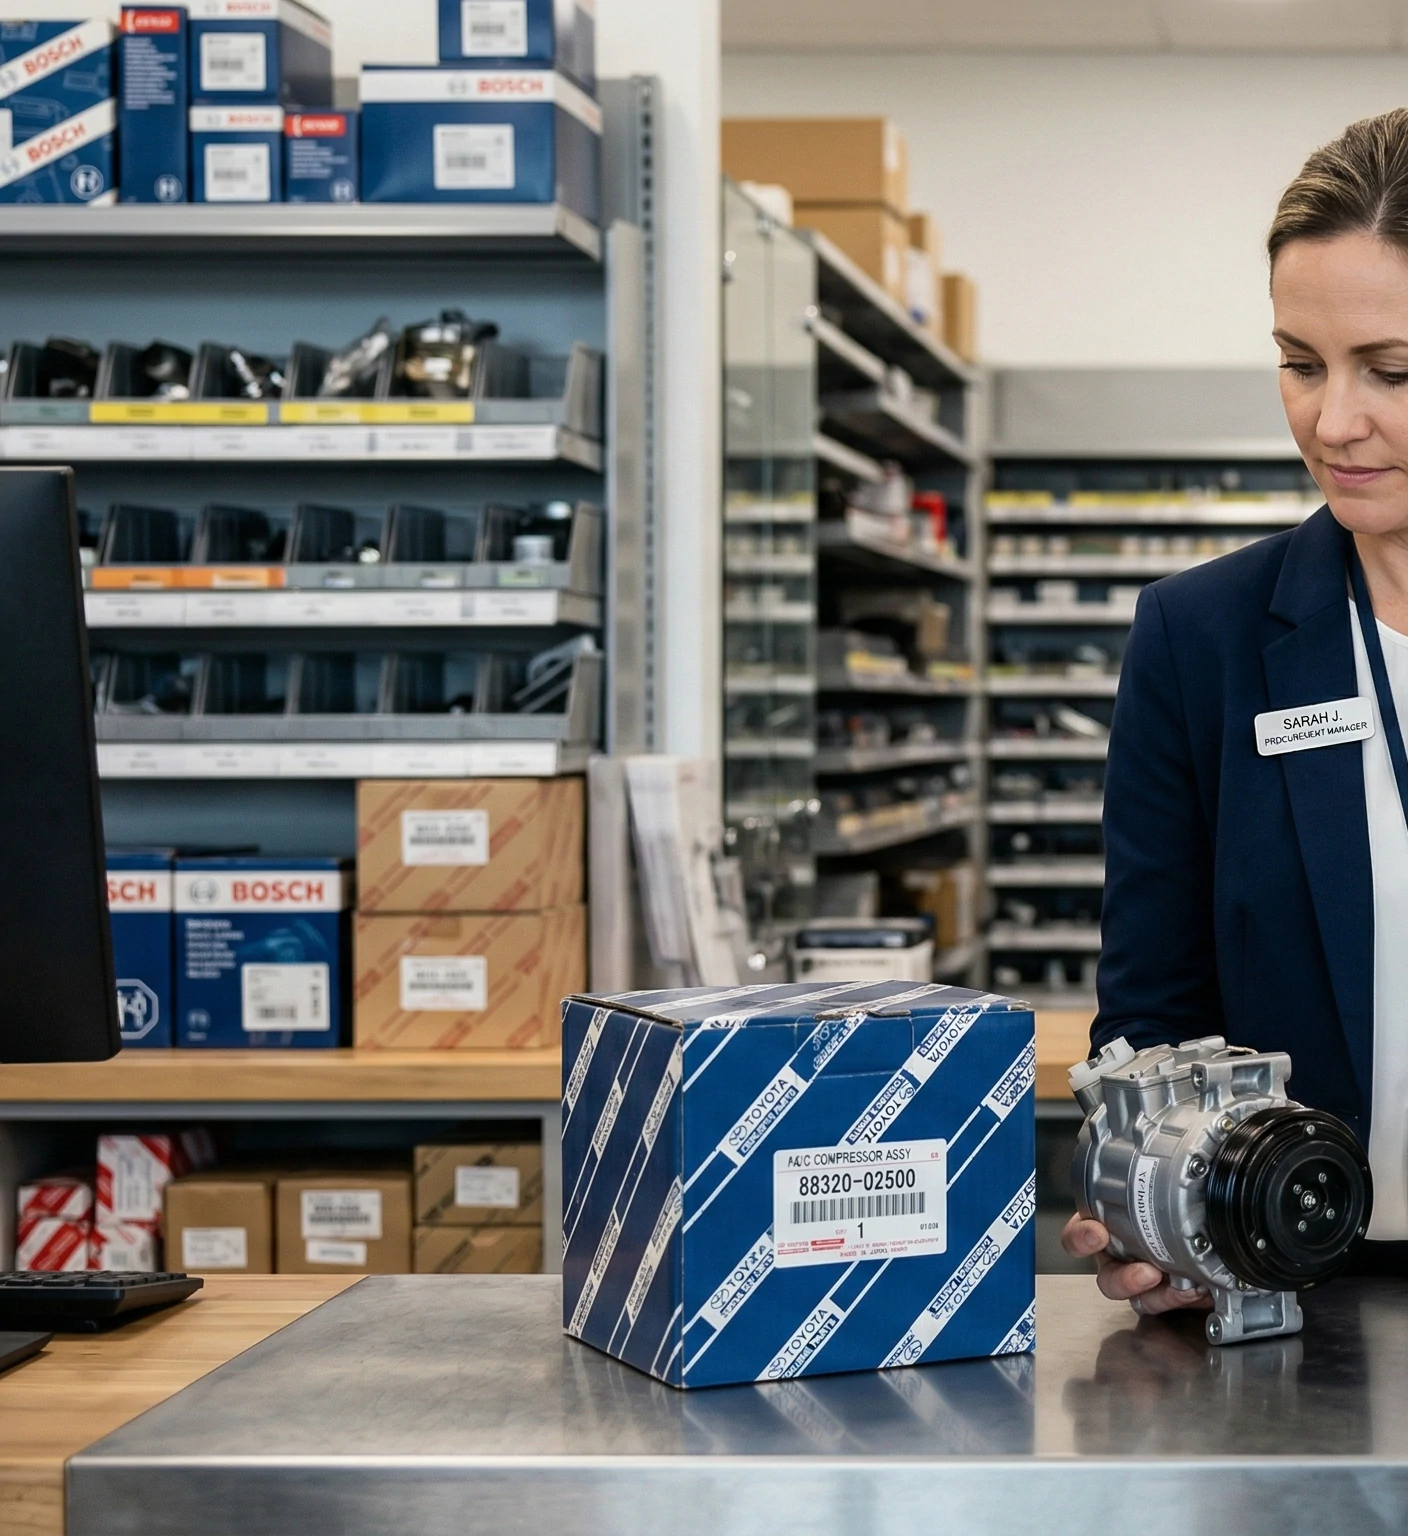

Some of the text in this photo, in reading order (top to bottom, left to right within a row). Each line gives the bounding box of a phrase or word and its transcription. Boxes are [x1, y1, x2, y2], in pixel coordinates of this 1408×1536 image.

[23, 36, 82, 76] BOSCH
[478, 80, 543, 94] BOSCH
[27, 122, 86, 162] BOSCH
[1283, 710, 1343, 730] SARAH J.
[107, 881, 156, 902] SCH
[232, 881, 324, 902] BOSCH
[744, 1079, 788, 1125] TOYOTA
[885, 1148, 912, 1160] ASSY
[799, 1168, 916, 1196] 88320-02500
[857, 1222, 864, 1239] 1
[783, 1308, 828, 1356] TOYOTA
